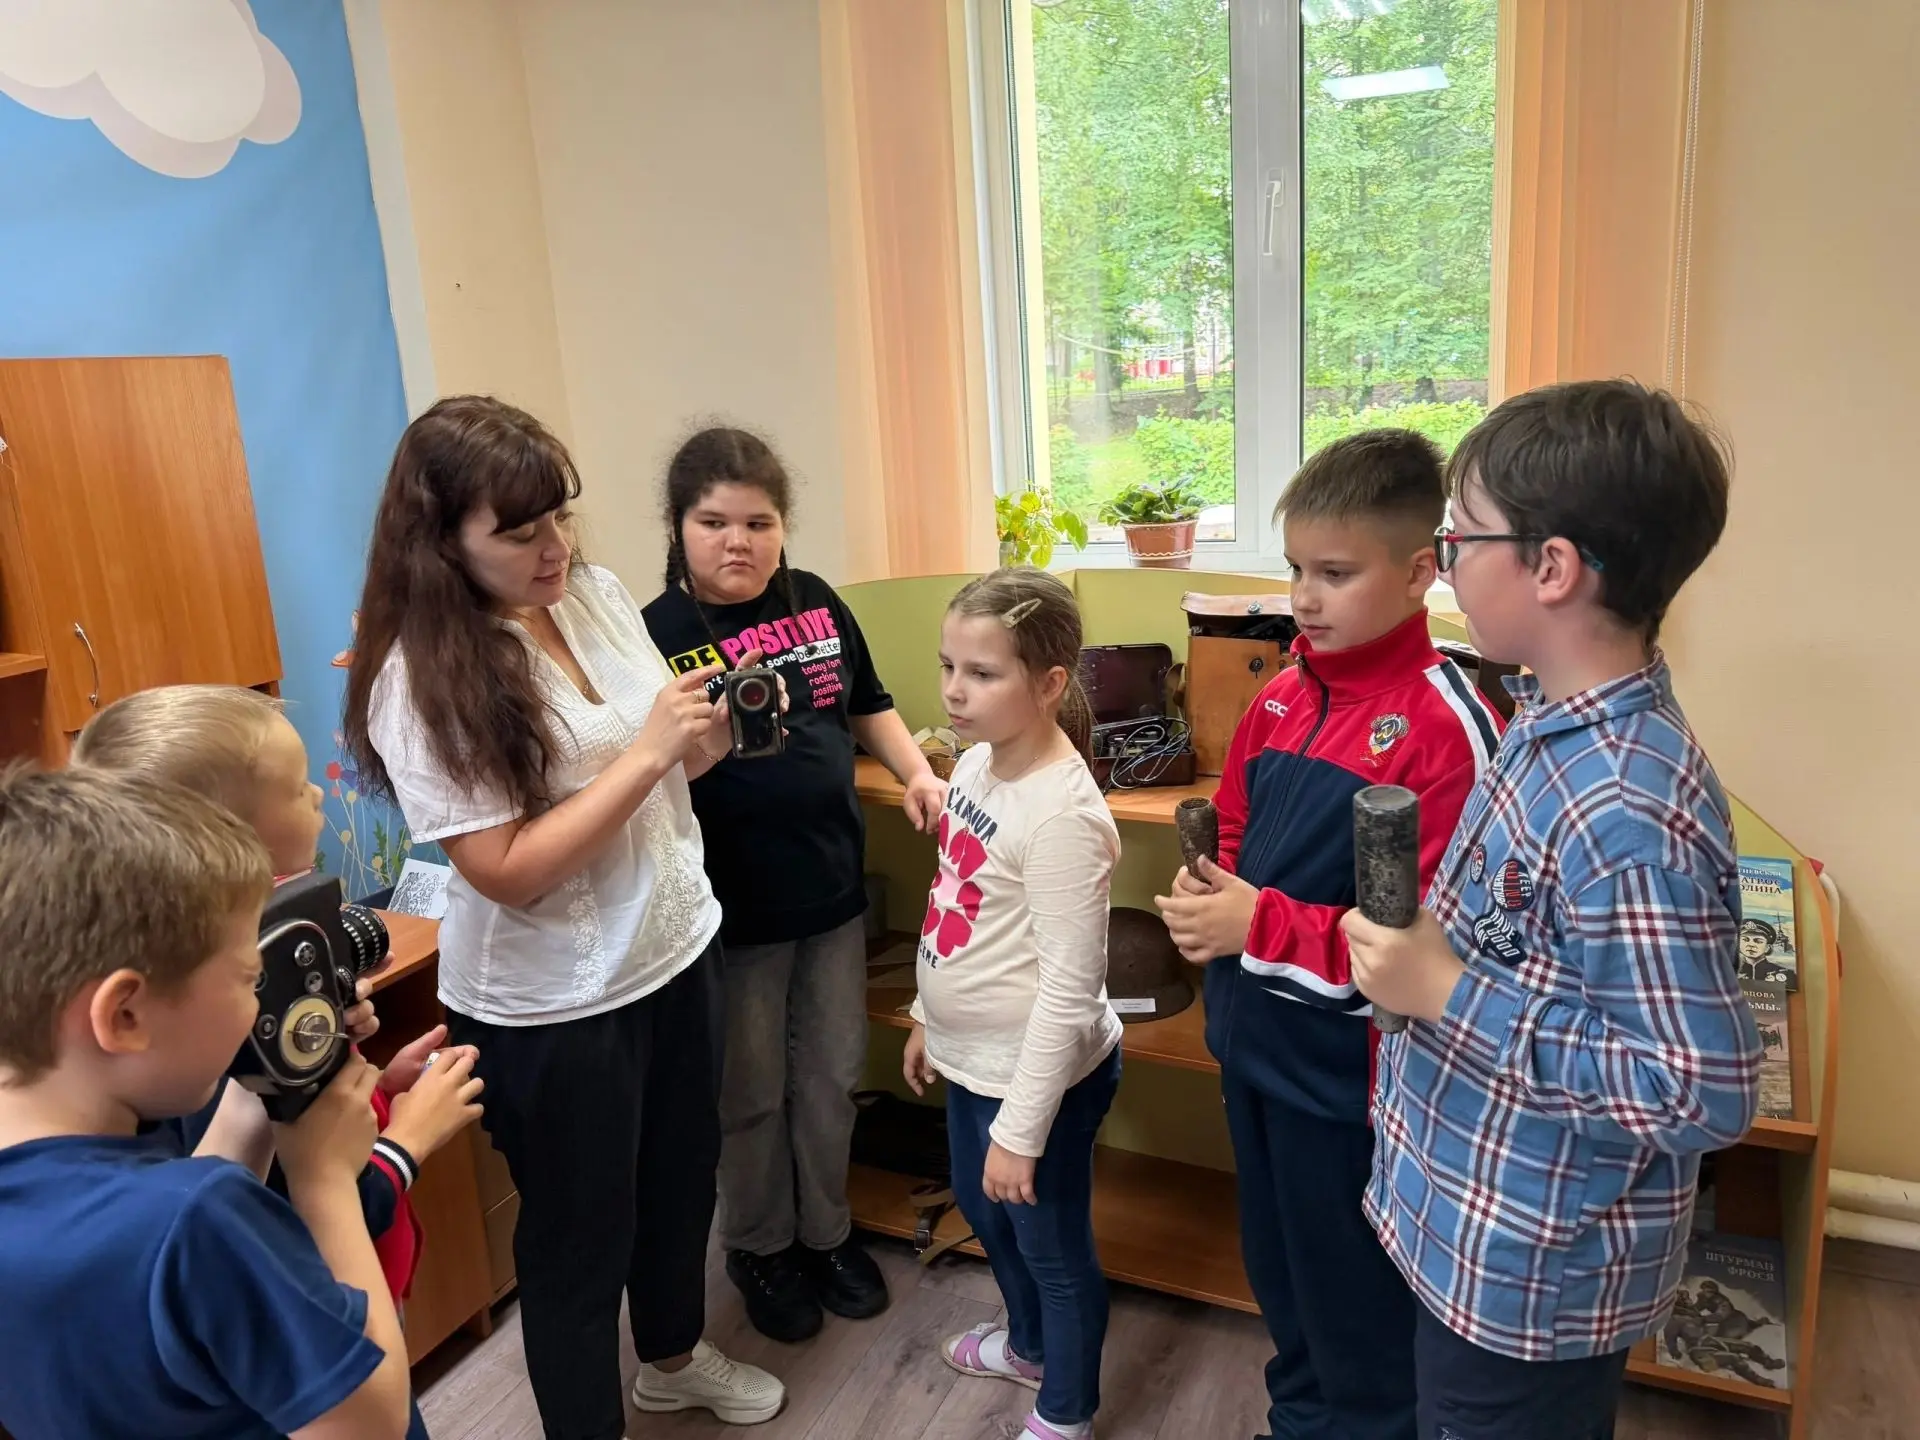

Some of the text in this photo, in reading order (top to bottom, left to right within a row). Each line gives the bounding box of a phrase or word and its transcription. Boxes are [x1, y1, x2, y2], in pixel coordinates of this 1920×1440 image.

[672, 607, 839, 675] BE POSITIVE
[766, 652, 797, 669] same
[801, 662, 828, 675] today
[809, 672, 839, 686] rocking
[813, 683, 843, 699] positive
[813, 697, 835, 708] vibes
